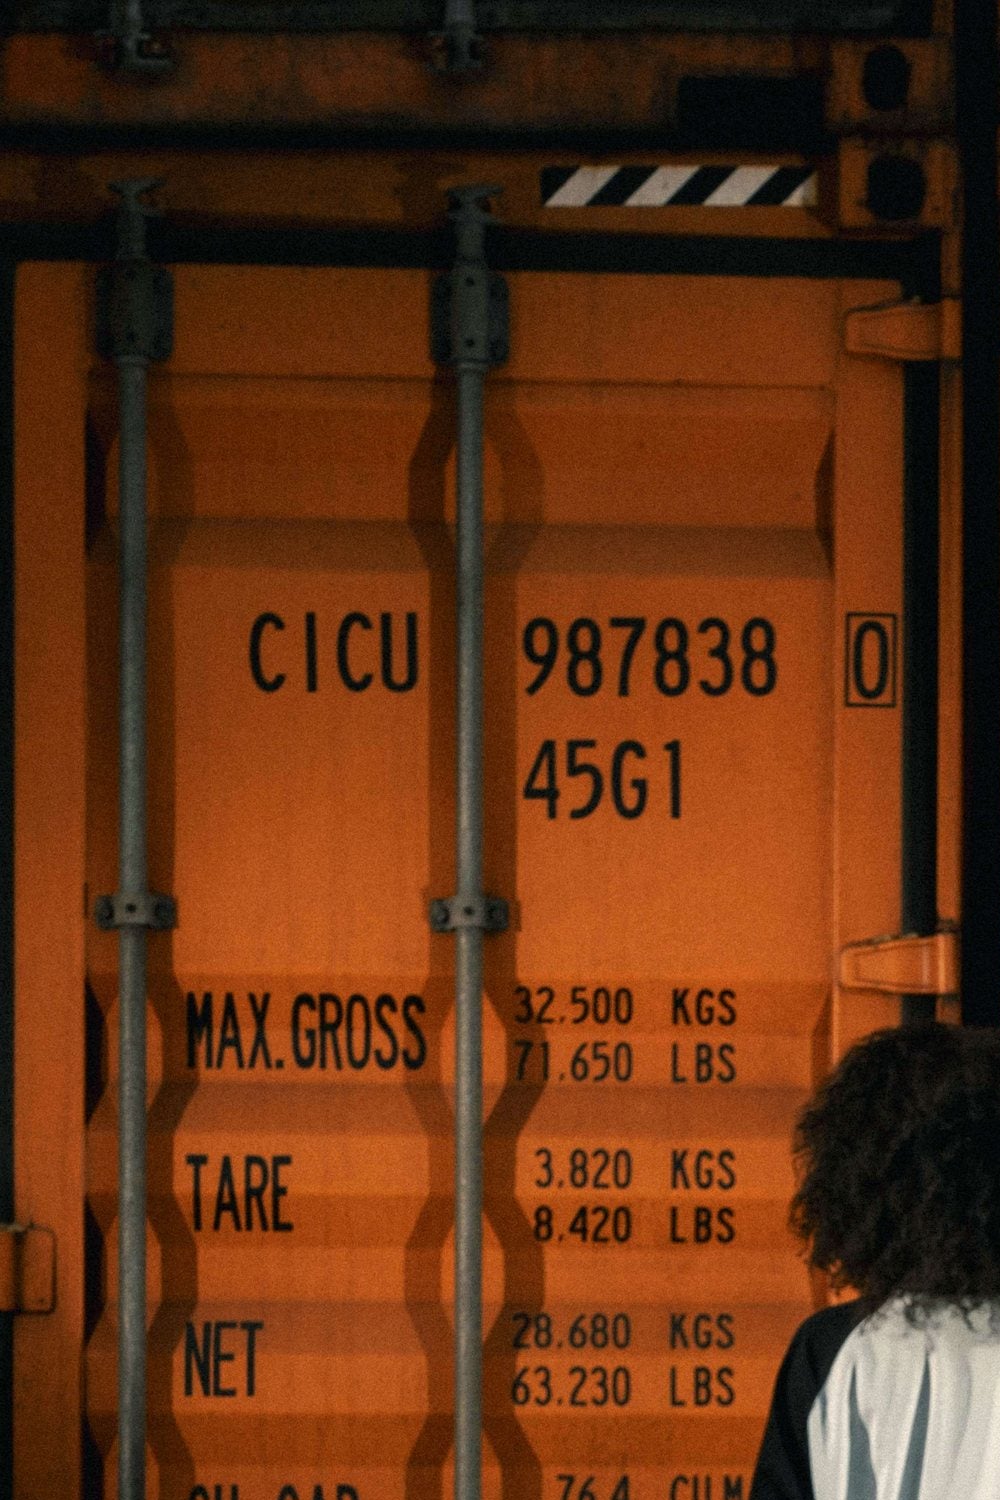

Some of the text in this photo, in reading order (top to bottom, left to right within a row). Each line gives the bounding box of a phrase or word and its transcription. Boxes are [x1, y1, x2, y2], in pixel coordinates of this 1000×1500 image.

[249, 611, 419, 694] CICU
[522, 616, 778, 698] 987838
[522, 739, 682, 820] 45G1
[514, 985, 737, 1026] 32.500 KGS
[185, 991, 427, 1071] MAX.GROSS
[514, 1039, 737, 1083] 71.650 LBS
[535, 1148, 736, 1190] 3.820 KGS
[185, 1153, 294, 1233] TARE
[533, 1204, 736, 1244] 8.420 LBS
[511, 1312, 735, 1349] 28.680 KGS
[184, 1320, 264, 1398] NET
[511, 1365, 736, 1407] 63.230 LBS
